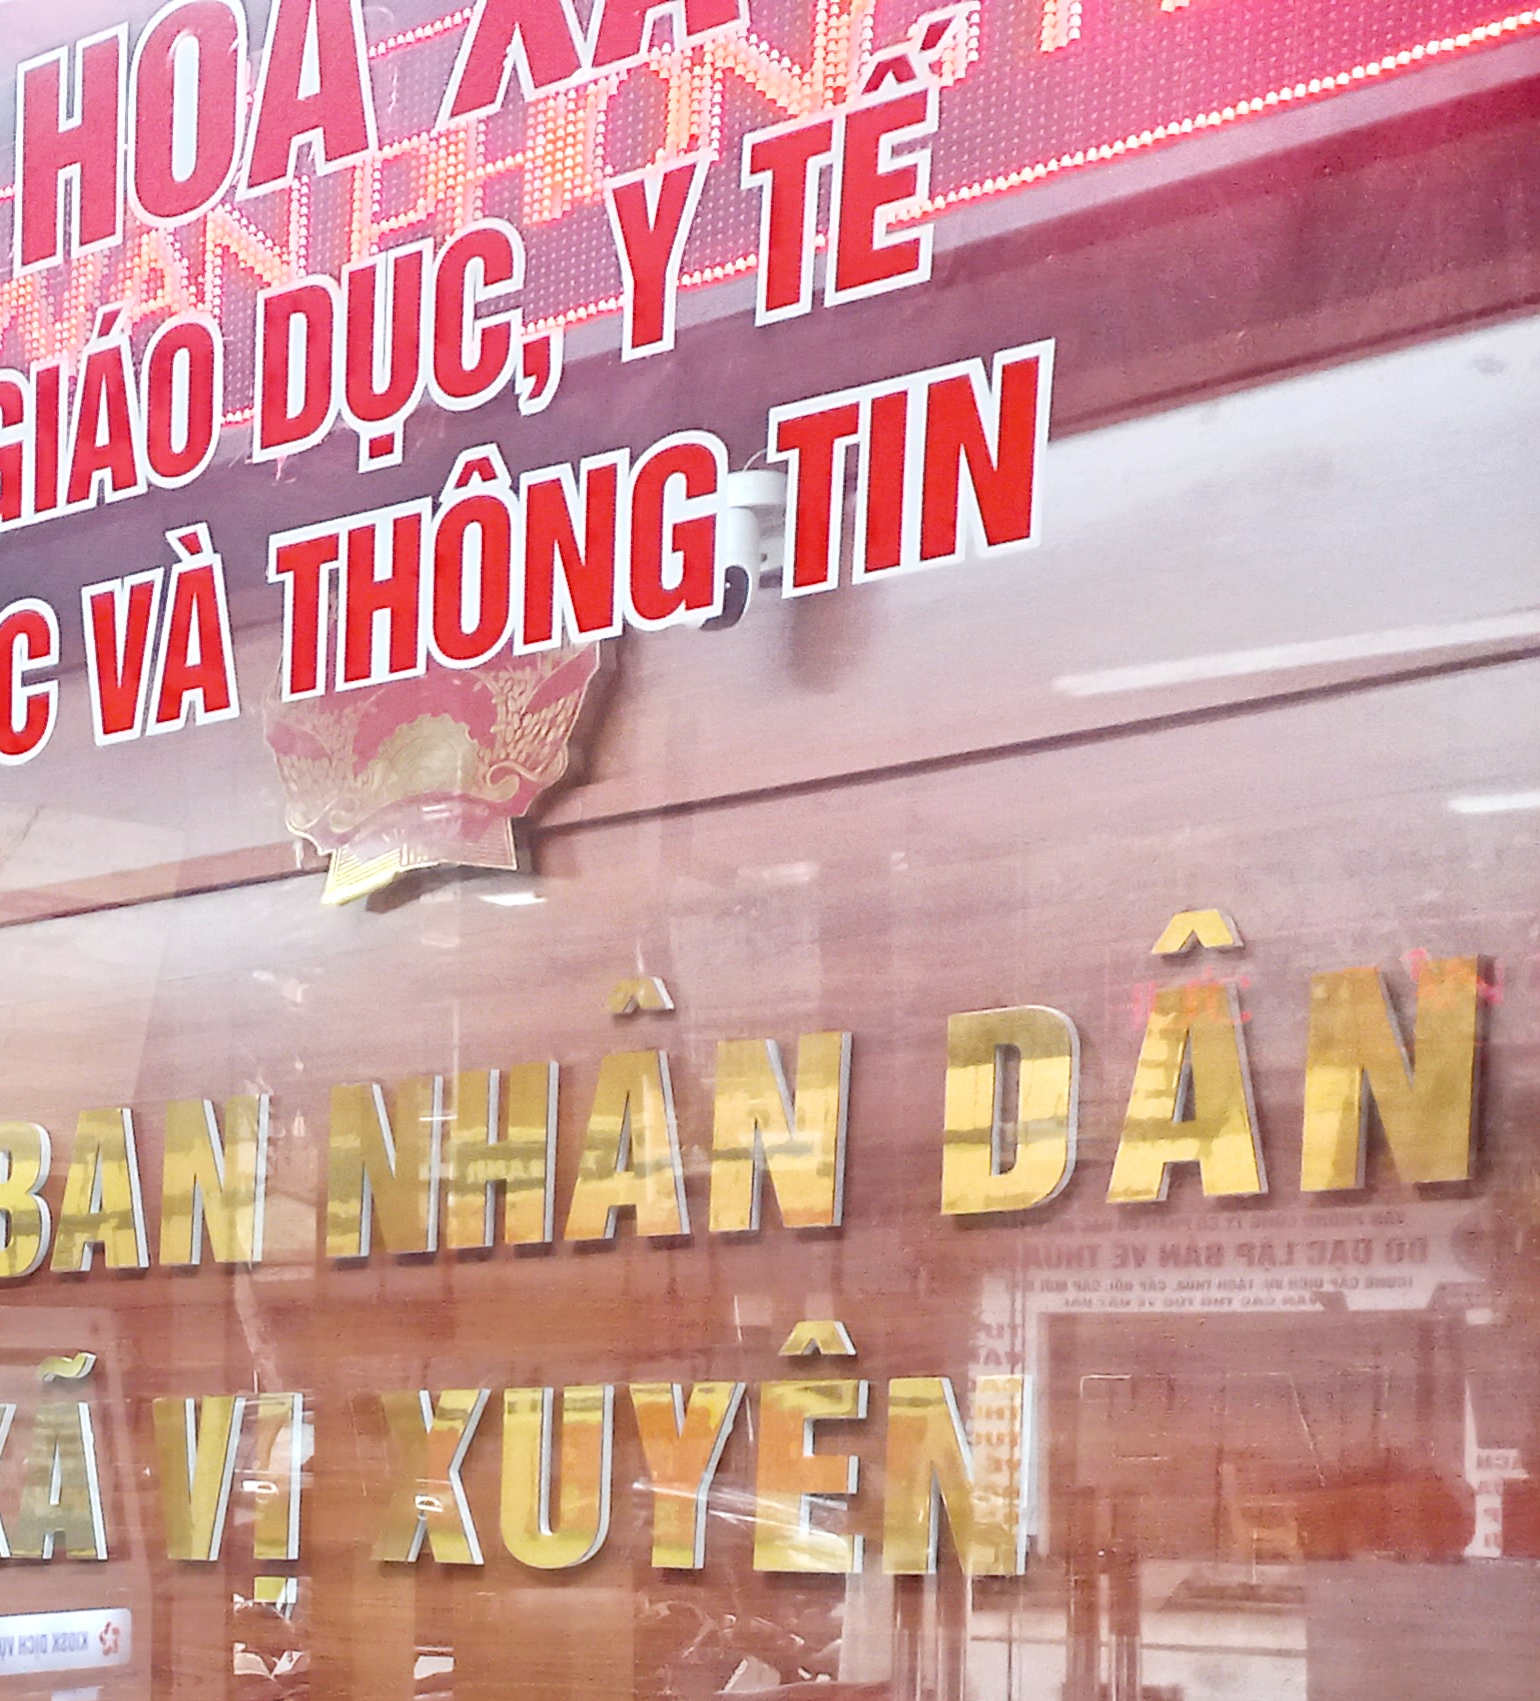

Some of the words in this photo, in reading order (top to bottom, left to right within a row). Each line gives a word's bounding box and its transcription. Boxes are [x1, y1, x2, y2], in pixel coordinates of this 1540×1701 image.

[253, 216, 564, 475] DỤC,
[606, 151, 719, 362] Y
[741, 8, 969, 328] TẾ
[81, 526, 242, 746] VÀ
[269, 428, 728, 703] THÔNG
[768, 339, 1055, 598] TIN
[324, 975, 853, 1263] NHÂN
[941, 909, 1496, 1215] DÂN
[155, 1387, 314, 1605] VỊ
[374, 1320, 1034, 1578] XUYÊN
